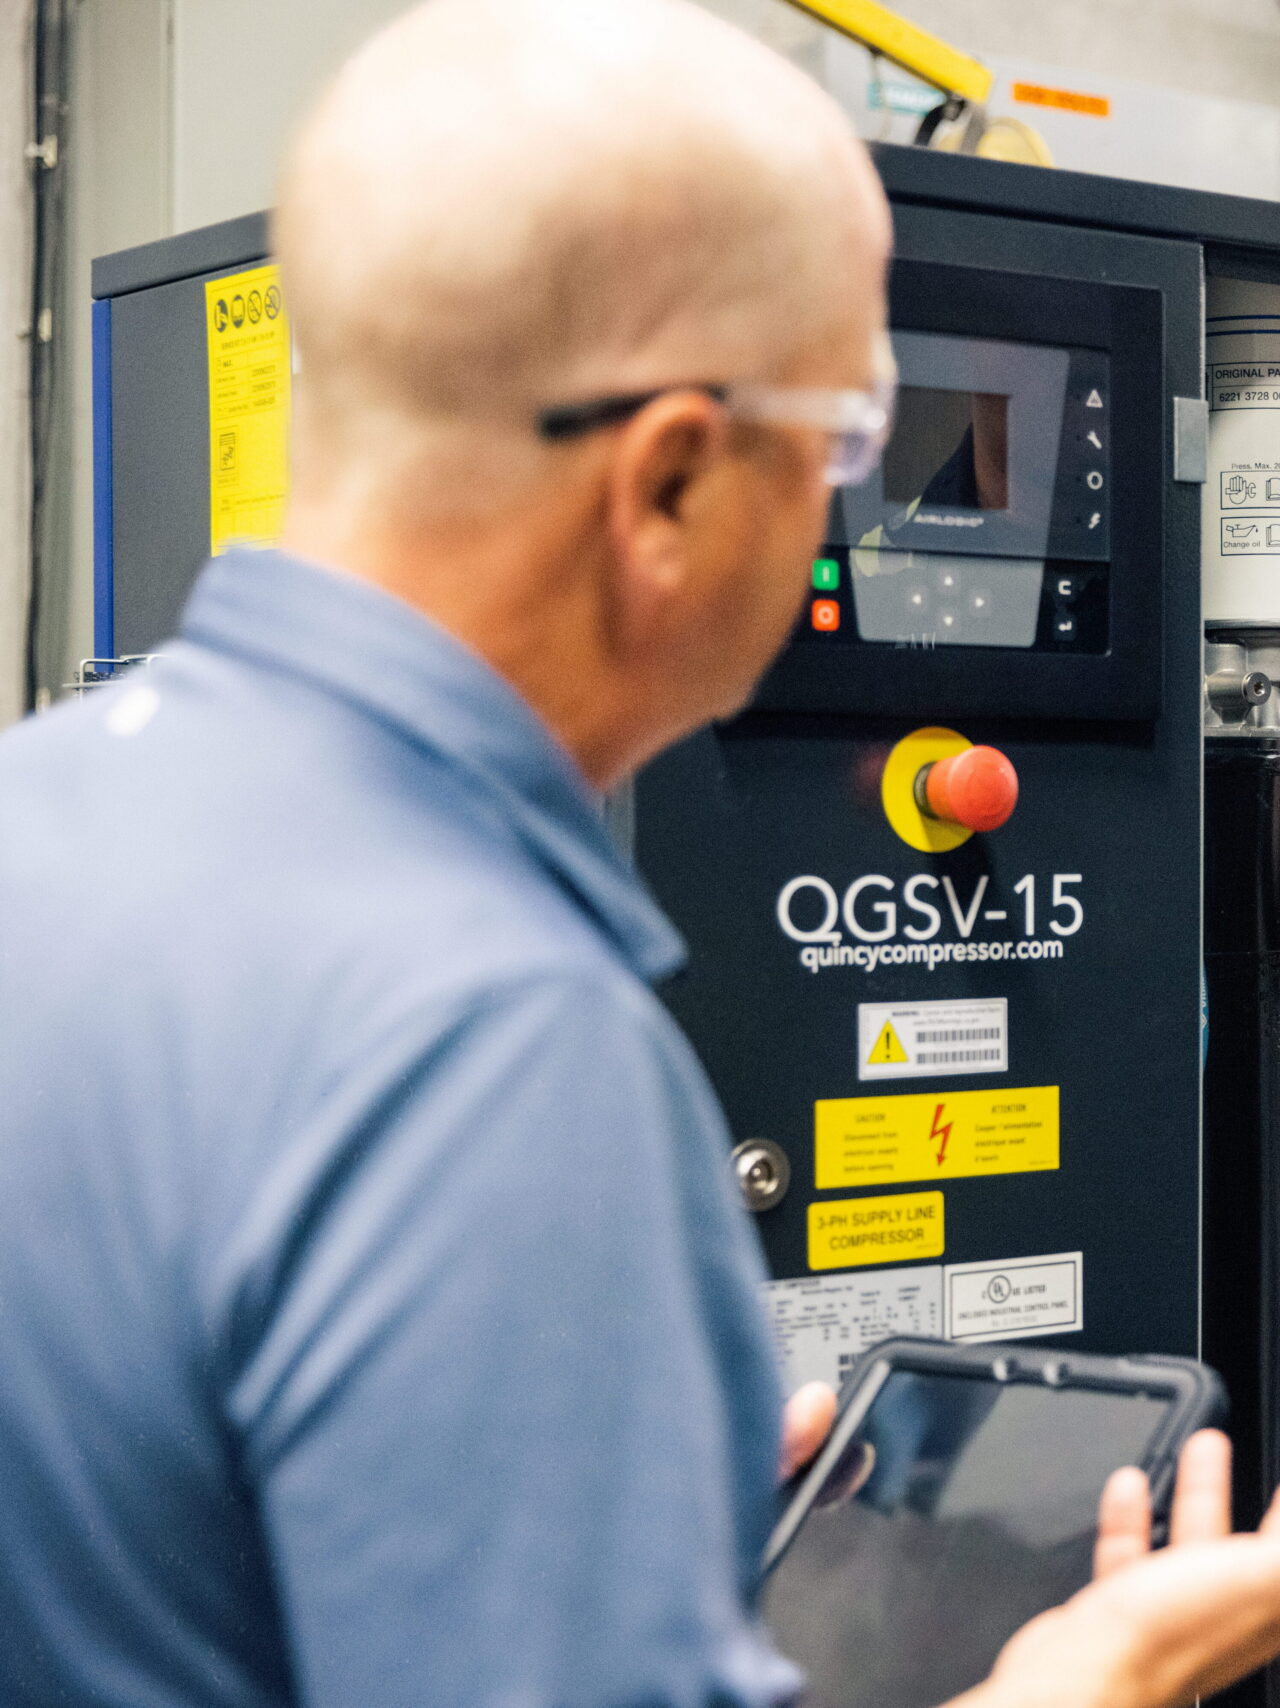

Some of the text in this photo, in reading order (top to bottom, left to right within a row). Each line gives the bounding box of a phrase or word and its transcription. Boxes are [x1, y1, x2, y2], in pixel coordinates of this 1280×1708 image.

[1215, 368, 1264, 379] ORIGINAL
[1219, 392, 1240, 402] 6221
[1244, 391, 1269, 401] 3728
[1223, 541, 1250, 549] Change
[777, 873, 1084, 943] QGSV-15
[801, 939, 1064, 974] quincycompressor.com
[817, 1205, 936, 1231] 3-PH SUPPLY LINE
[829, 1227, 925, 1251] COMPRESSOR
